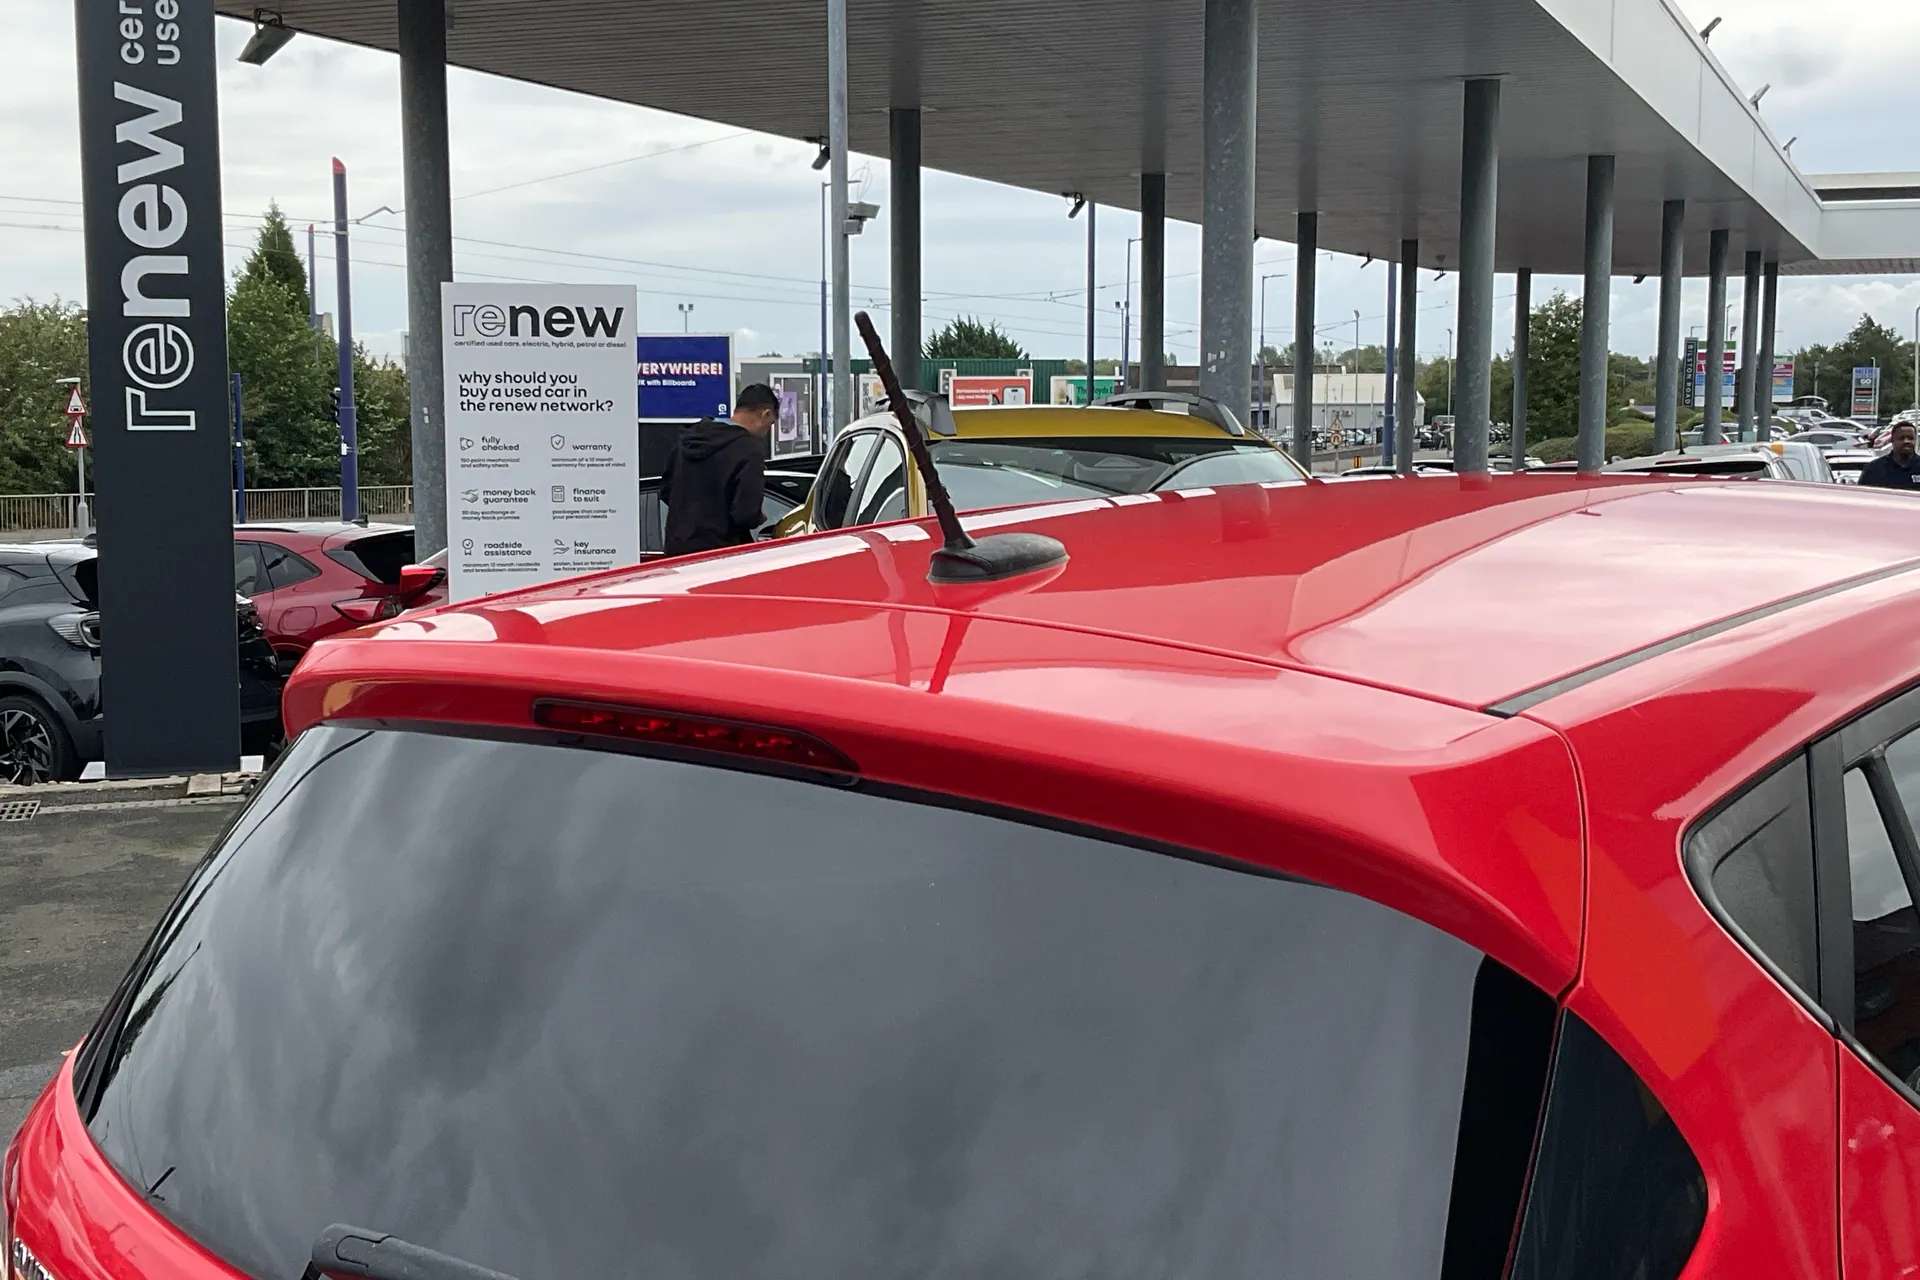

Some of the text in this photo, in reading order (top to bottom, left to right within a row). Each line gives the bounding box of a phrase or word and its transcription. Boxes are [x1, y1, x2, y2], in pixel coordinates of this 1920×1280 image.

[119, 0, 145, 65] cer
[114, 81, 196, 431] renew
[453, 304, 625, 338] renew
[459, 371, 578, 386] why should you
[459, 385, 587, 400] buy a used car in
[460, 400, 614, 412] the renew network?
[481, 436, 500, 445] fully
[481, 443, 520, 451] checked
[572, 443, 612, 452] warranty
[482, 487, 536, 497] money back
[572, 487, 606, 496] finance
[482, 496, 529, 505] guarantee
[572, 495, 600, 503] to suit
[483, 541, 523, 549] roadside
[573, 540, 589, 549] key
[483, 548, 532, 556] assistance
[573, 547, 617, 555] insurance
